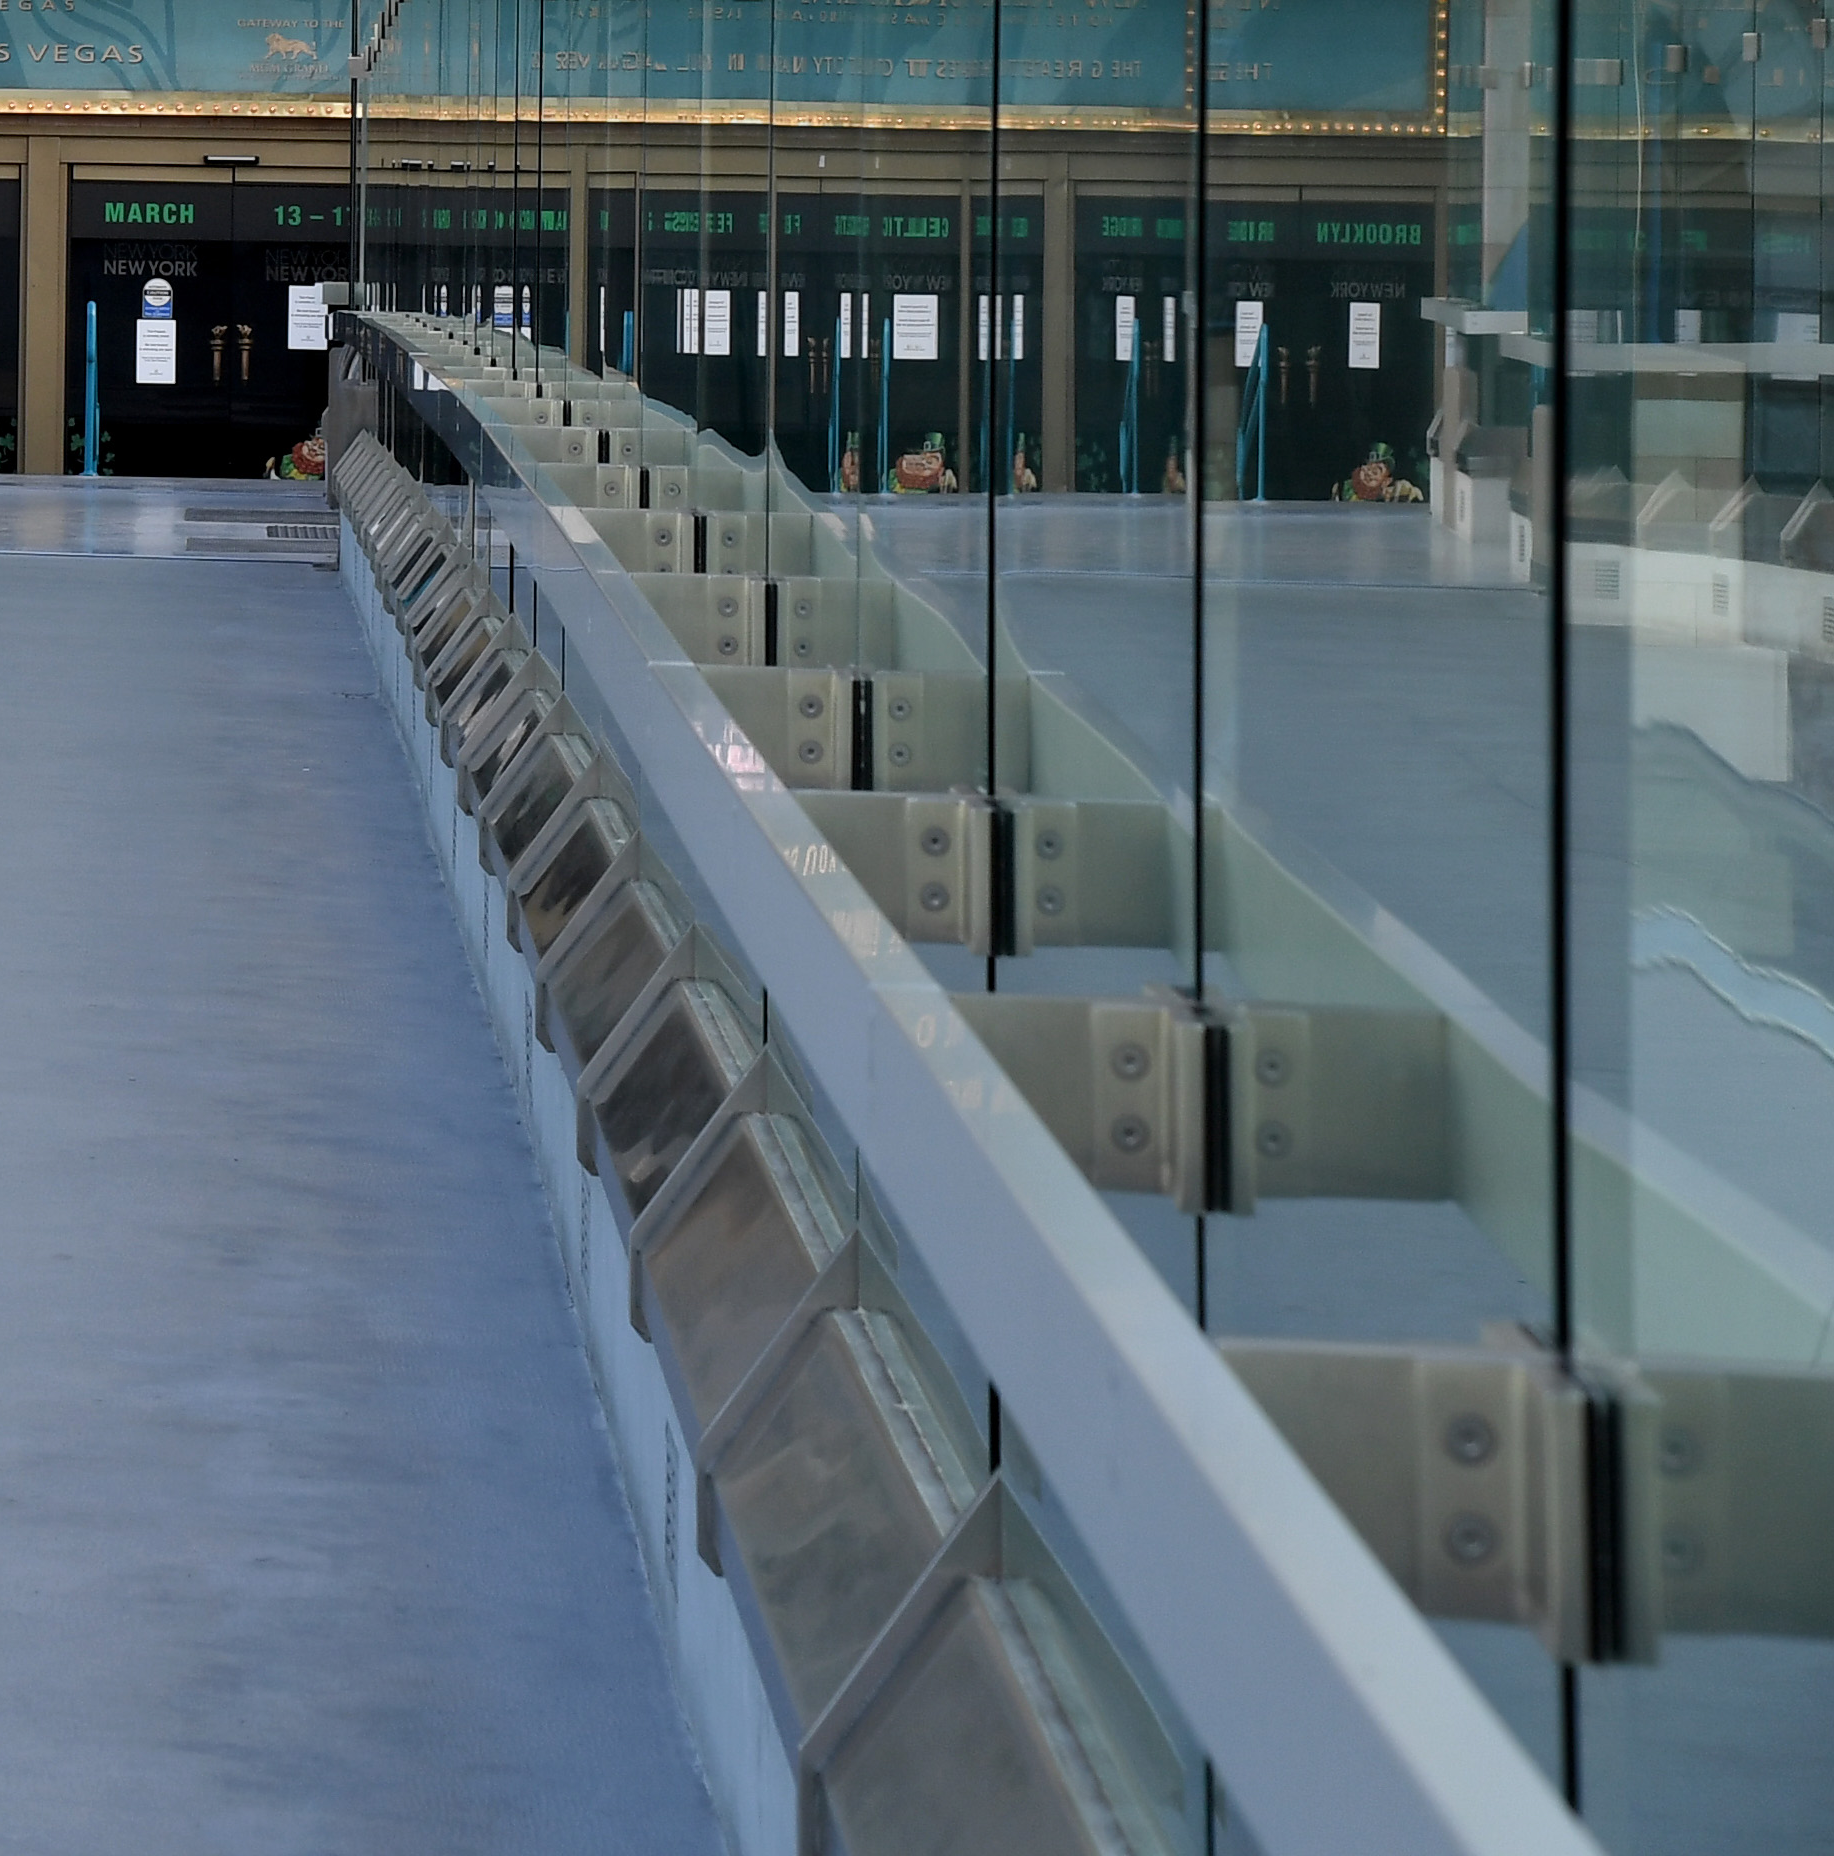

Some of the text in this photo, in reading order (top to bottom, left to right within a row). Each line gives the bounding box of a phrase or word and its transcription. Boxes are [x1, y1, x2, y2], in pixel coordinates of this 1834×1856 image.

[237, 18, 346, 29] GATEWAY TO THE
[27, 43, 145, 64] VEGAS
[104, 201, 195, 224] MARCH
[273, 205, 302, 226] 13
[332, 206, 351, 226] 1
[104, 259, 198, 277] NEW YORK
[311, 266, 349, 282] YOR
